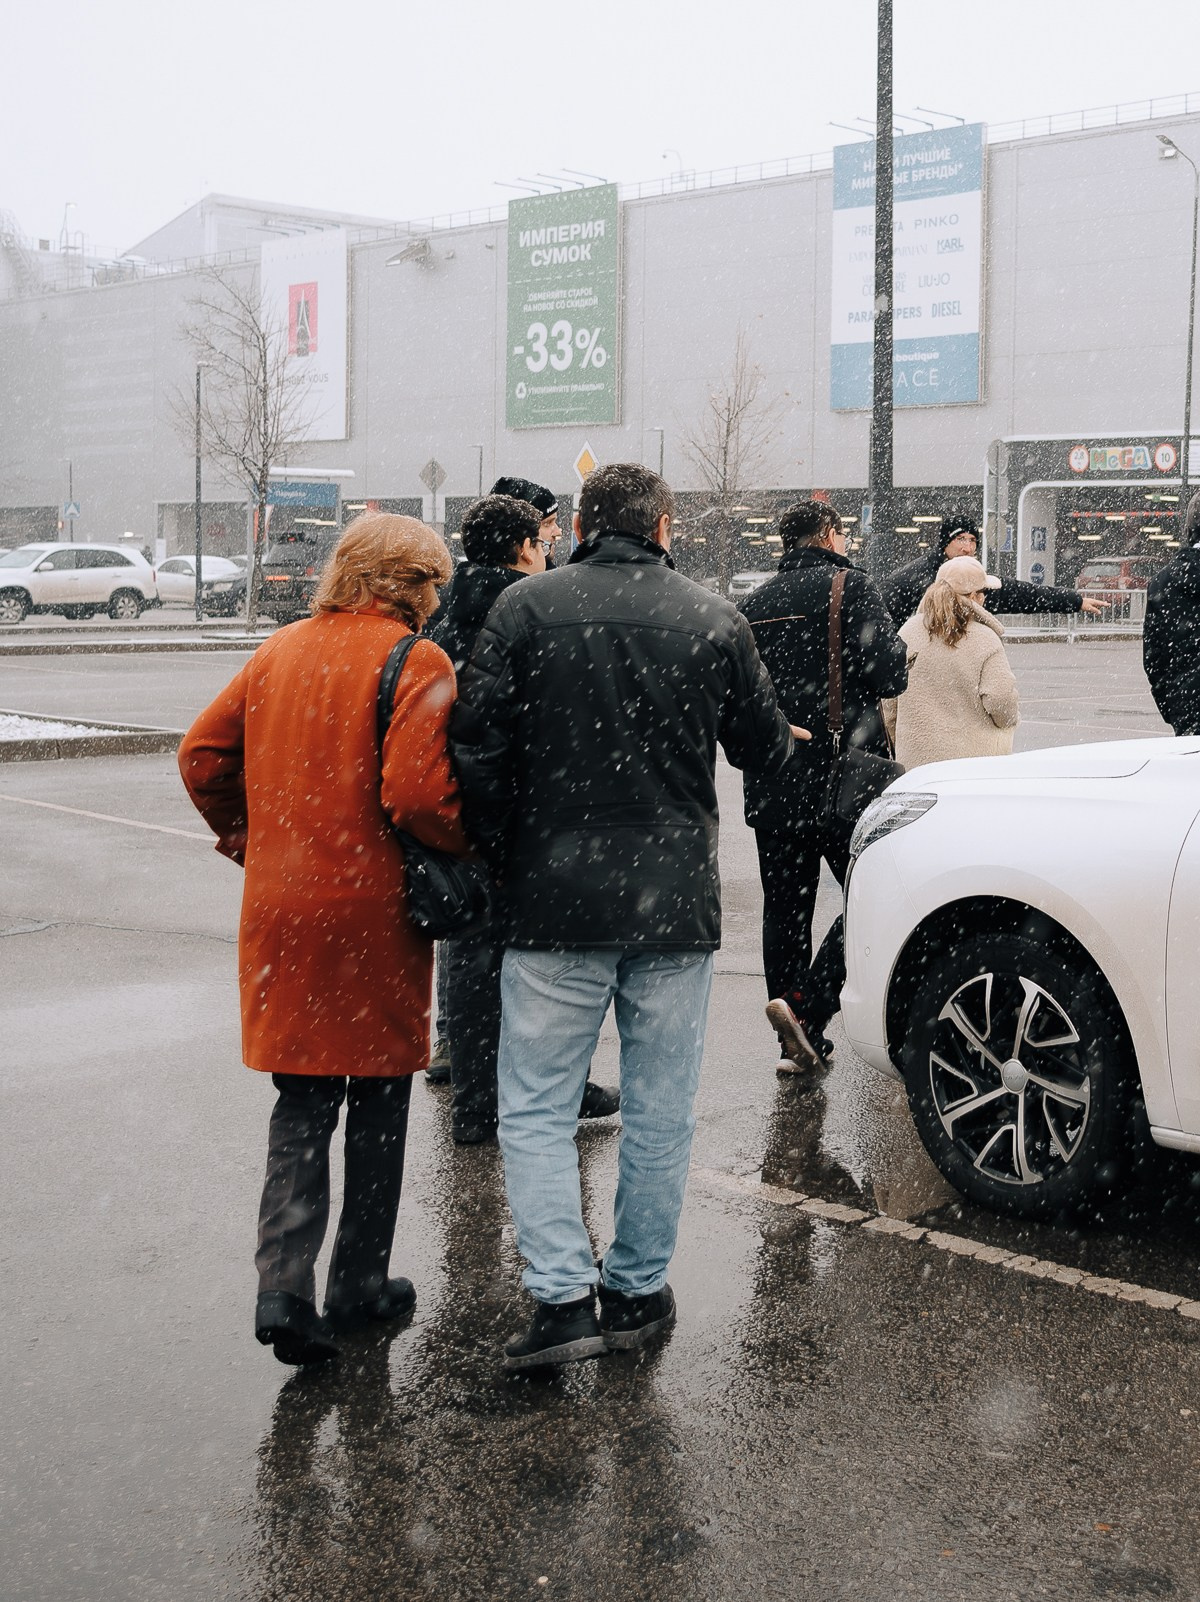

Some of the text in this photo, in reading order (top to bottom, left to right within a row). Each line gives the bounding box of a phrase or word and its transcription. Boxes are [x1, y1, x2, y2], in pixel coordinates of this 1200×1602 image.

[863, 148, 952, 173] НАИ ЛУЧШИЕ
[851, 171, 909, 190] МИРЫЕ
[519, 219, 605, 248] ИМПЕРИЯ
[854, 213, 960, 237] PRETA PINKO
[937, 237, 964, 250] KARL
[531, 243, 592, 267] СУМОК
[533, 301, 555, 312] НОВОЕ
[555, 299, 566, 310] СО
[931, 301, 962, 318] DIESEL
[513, 319, 607, 373] -33%
[867, 368, 939, 390] SACE
[1161, 453, 1171, 463] 10
